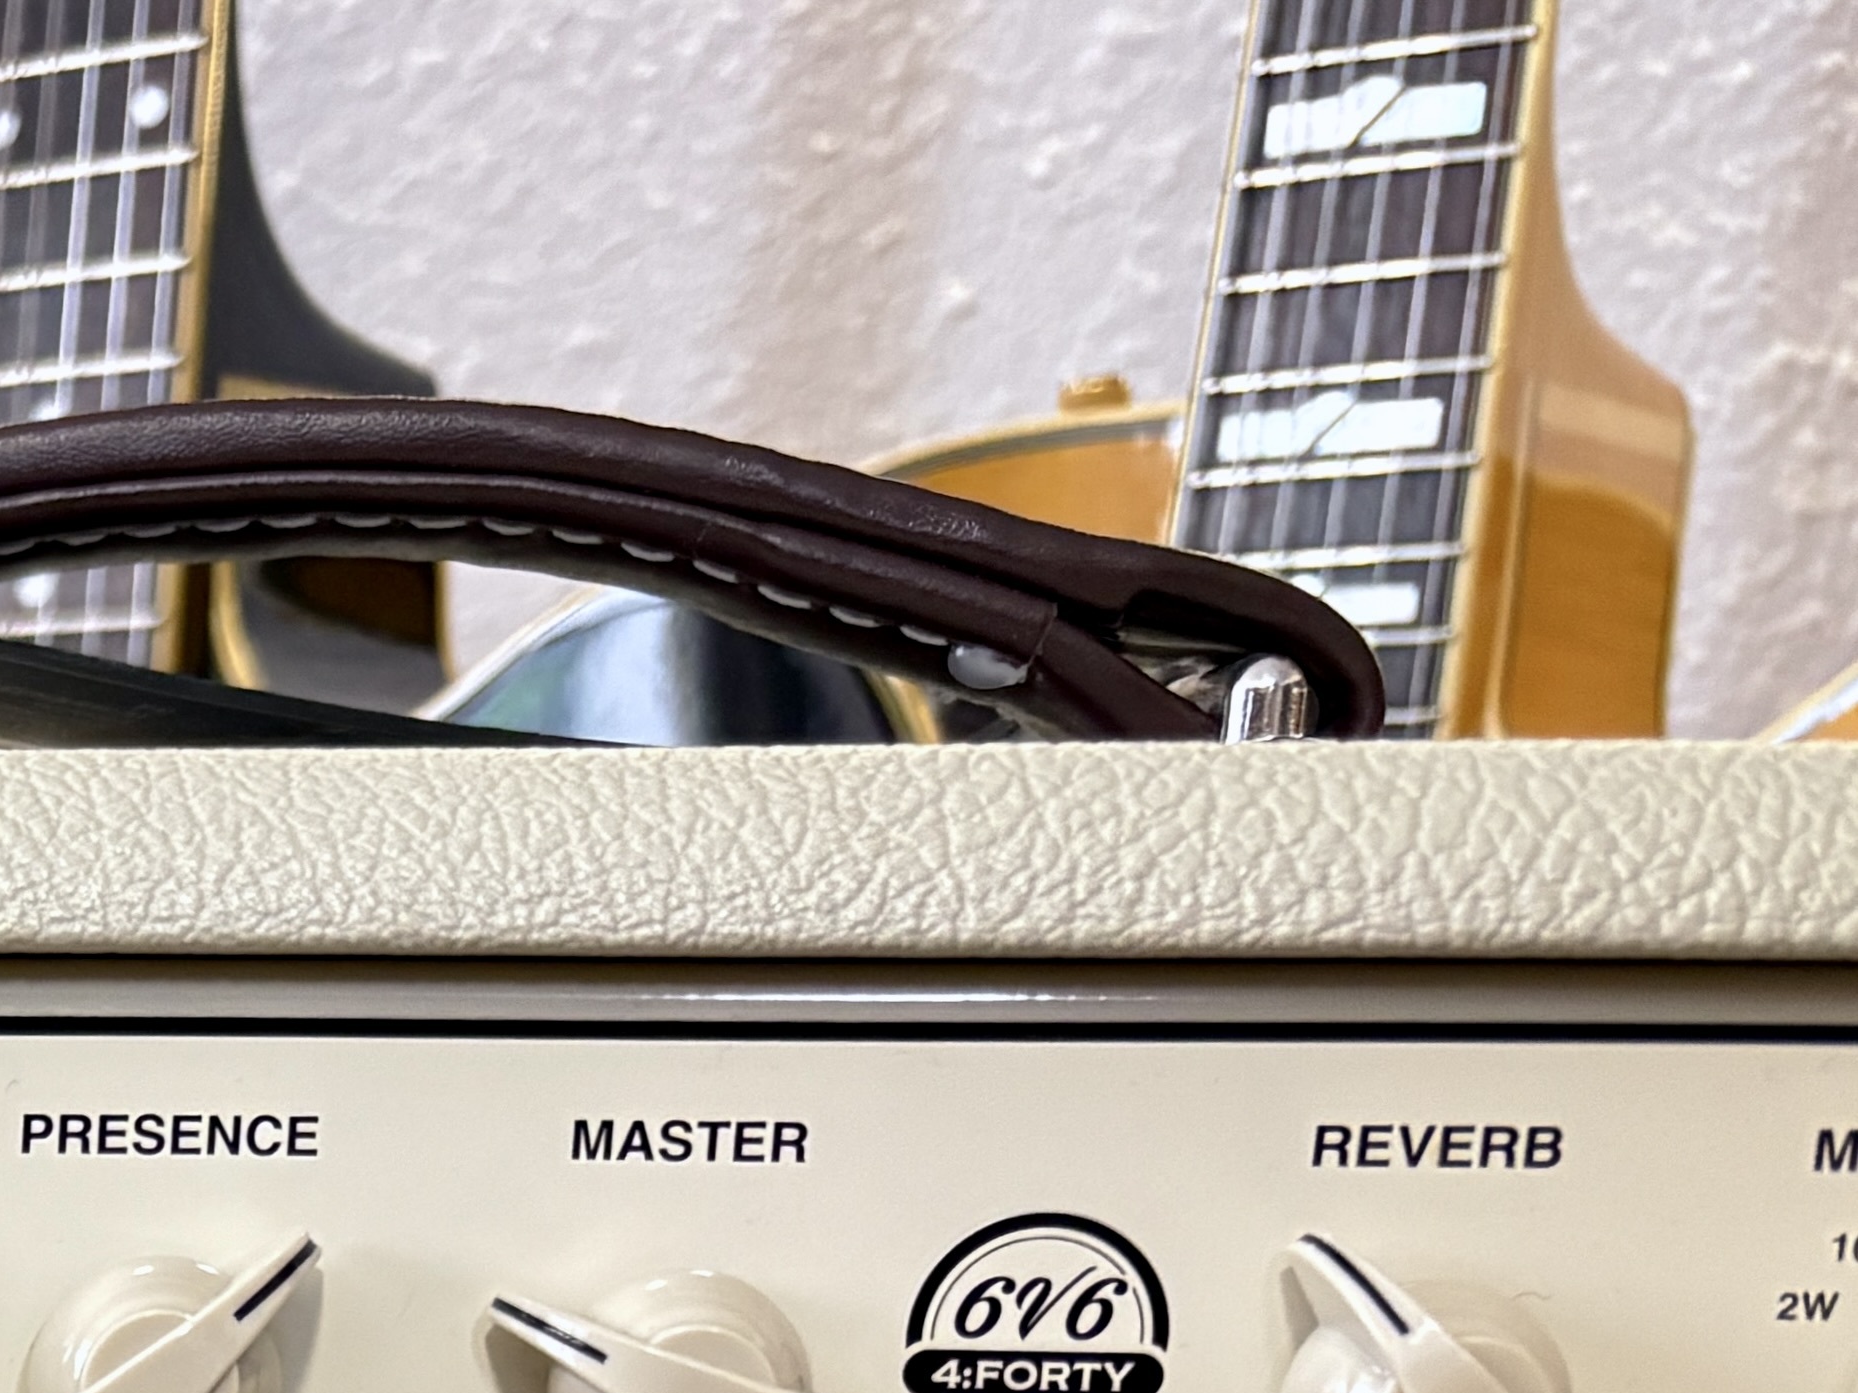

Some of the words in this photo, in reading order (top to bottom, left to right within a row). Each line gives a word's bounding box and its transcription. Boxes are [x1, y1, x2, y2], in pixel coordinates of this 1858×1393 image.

[21, 1113, 320, 1157] PRESENCE
[571, 1119, 808, 1163] MASTER
[1312, 1124, 1564, 1169] REVERB
[954, 1265, 1129, 1342] 6V6
[1775, 1291, 1840, 1322] 2W
[930, 1358, 1136, 1392] 4:FORTY
